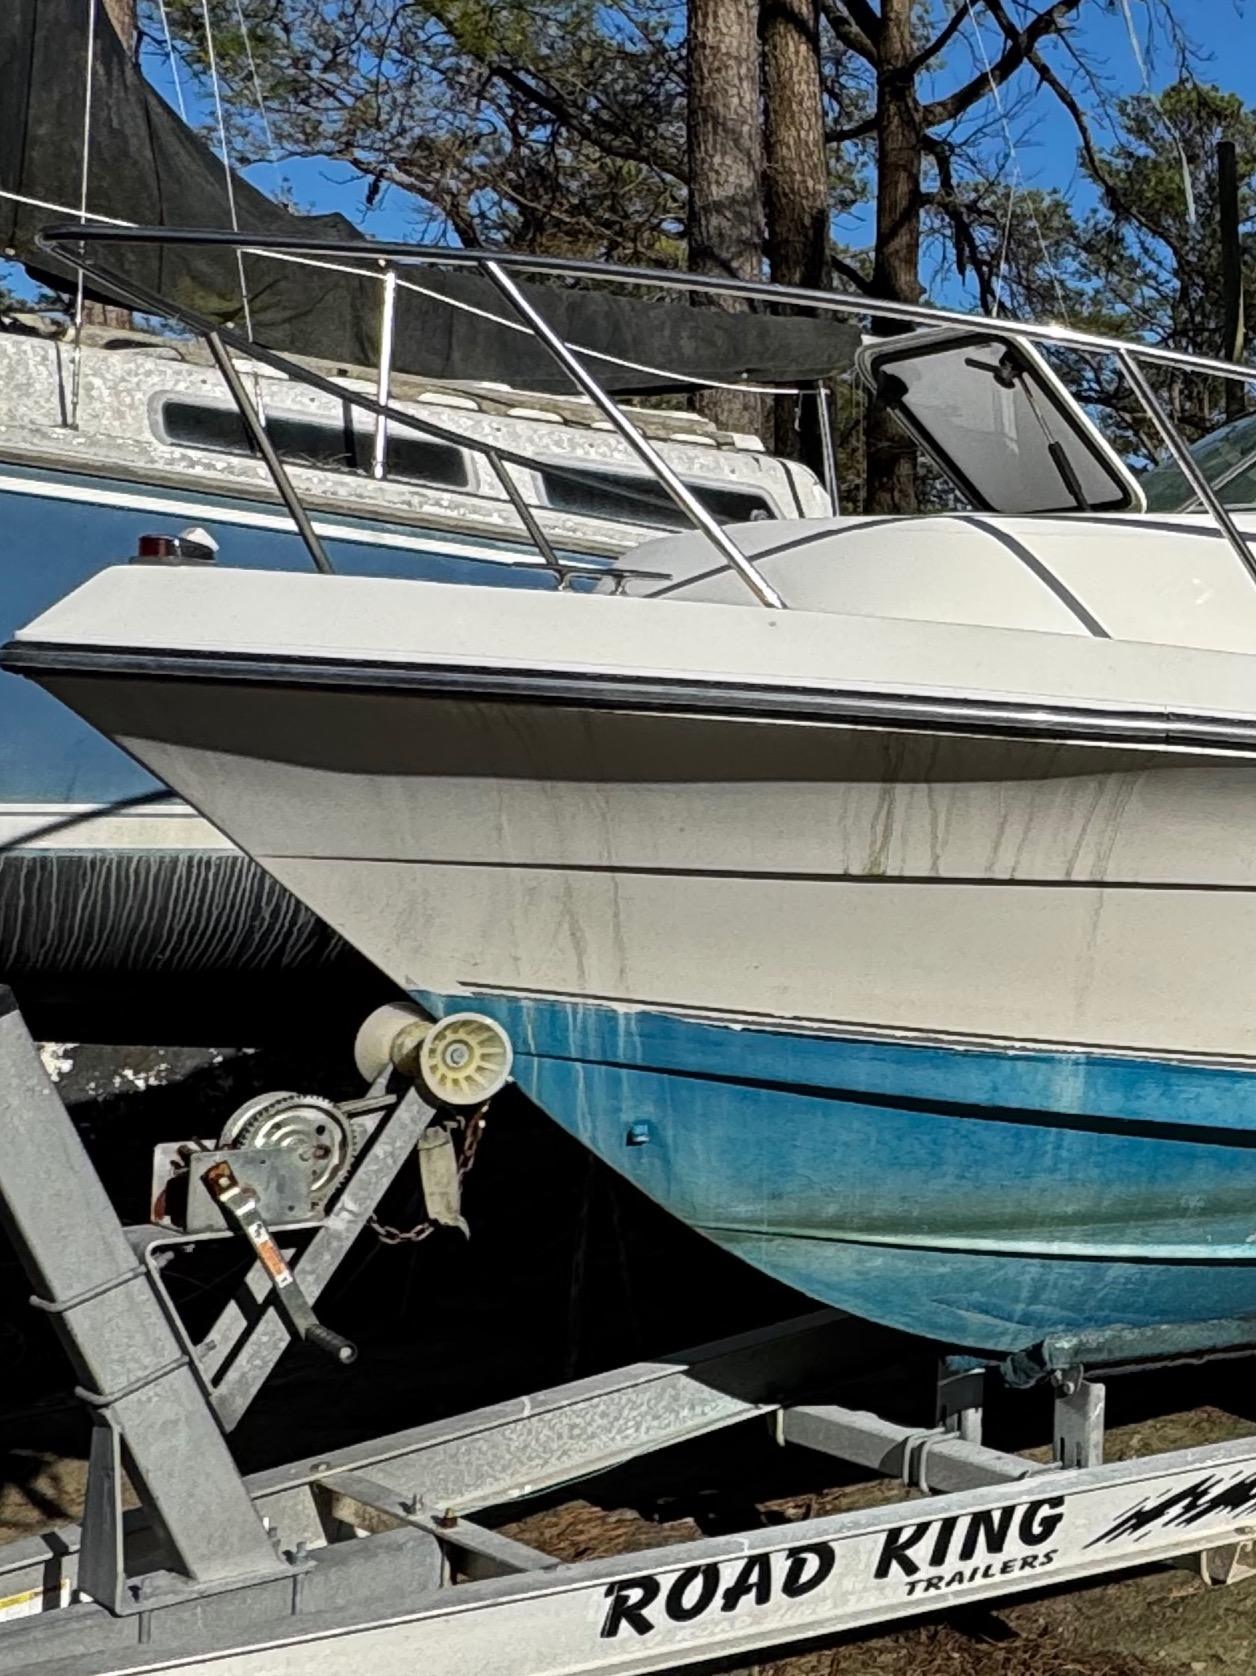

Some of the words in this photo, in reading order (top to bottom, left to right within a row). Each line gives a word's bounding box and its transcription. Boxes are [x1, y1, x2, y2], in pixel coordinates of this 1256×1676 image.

[600, 1542, 836, 1639] ROAD
[873, 1496, 1065, 1580] KING
[905, 1548, 1059, 1597] TRAILERS
